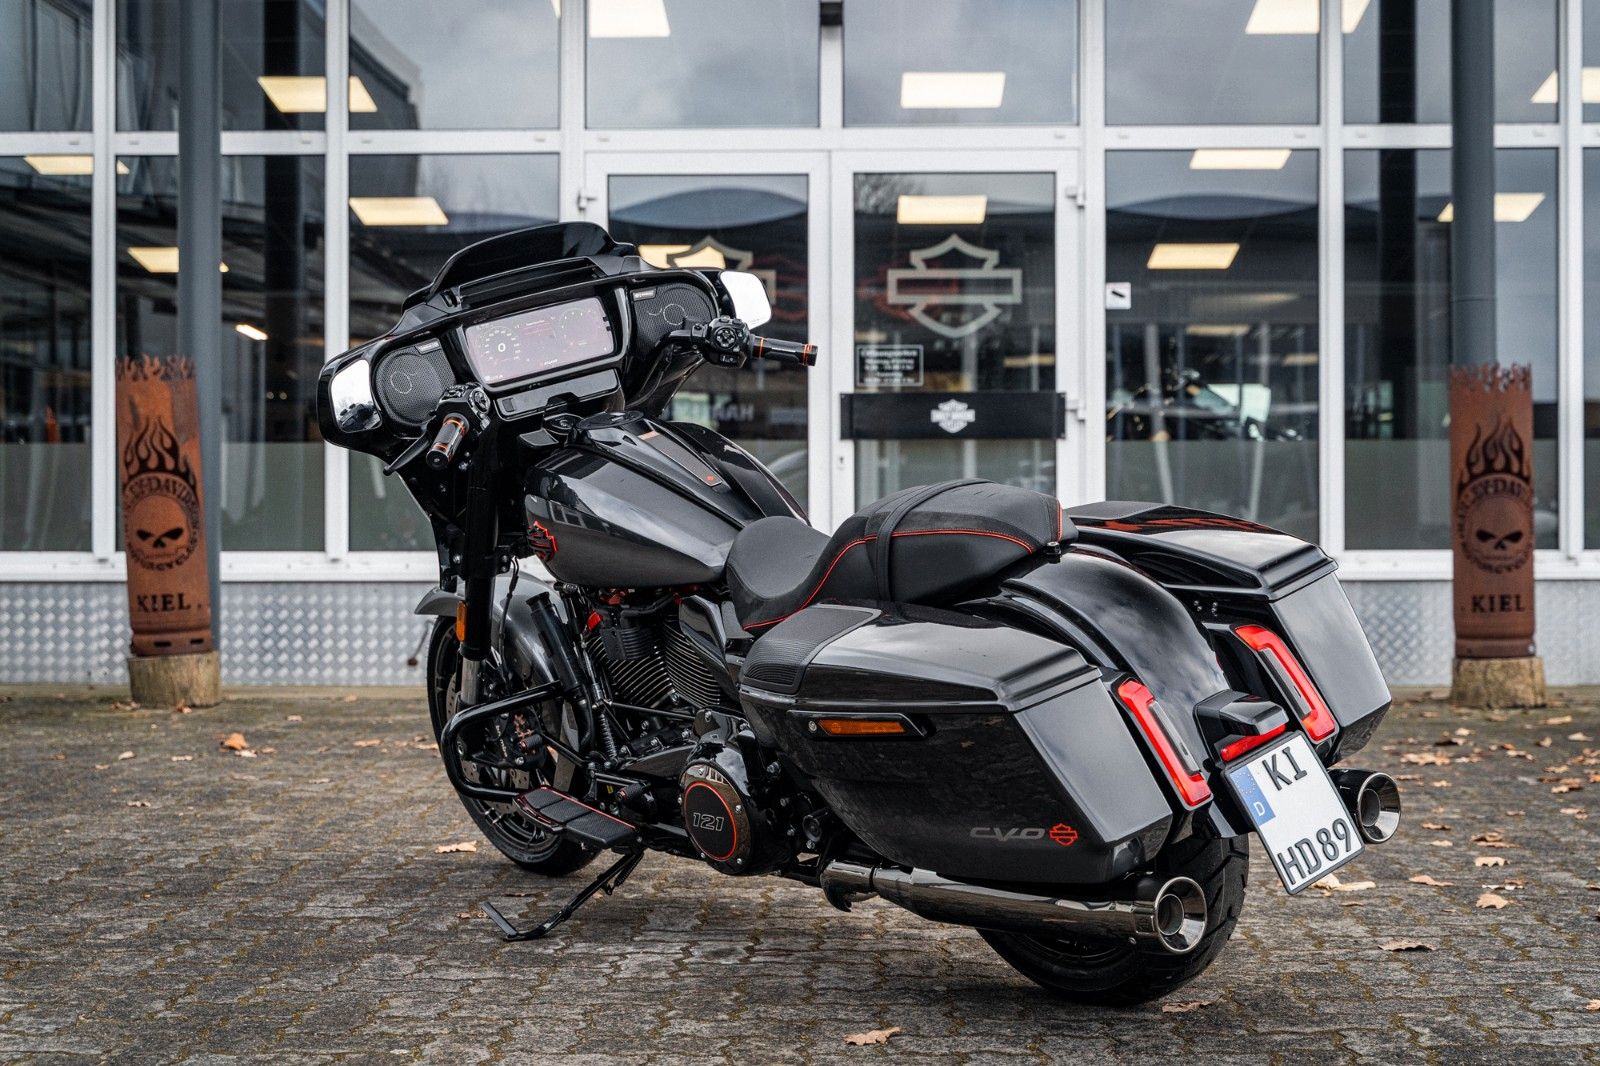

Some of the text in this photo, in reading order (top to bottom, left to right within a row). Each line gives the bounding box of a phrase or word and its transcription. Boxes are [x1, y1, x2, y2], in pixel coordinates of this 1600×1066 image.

[497, 342, 506, 353] 0
[137, 592, 192, 613] KIEL
[1471, 593, 1526, 613] KIEL
[1262, 746, 1308, 791] KI
[1253, 801, 1266, 817] D
[693, 812, 724, 832] 121
[970, 827, 1045, 841] CVO
